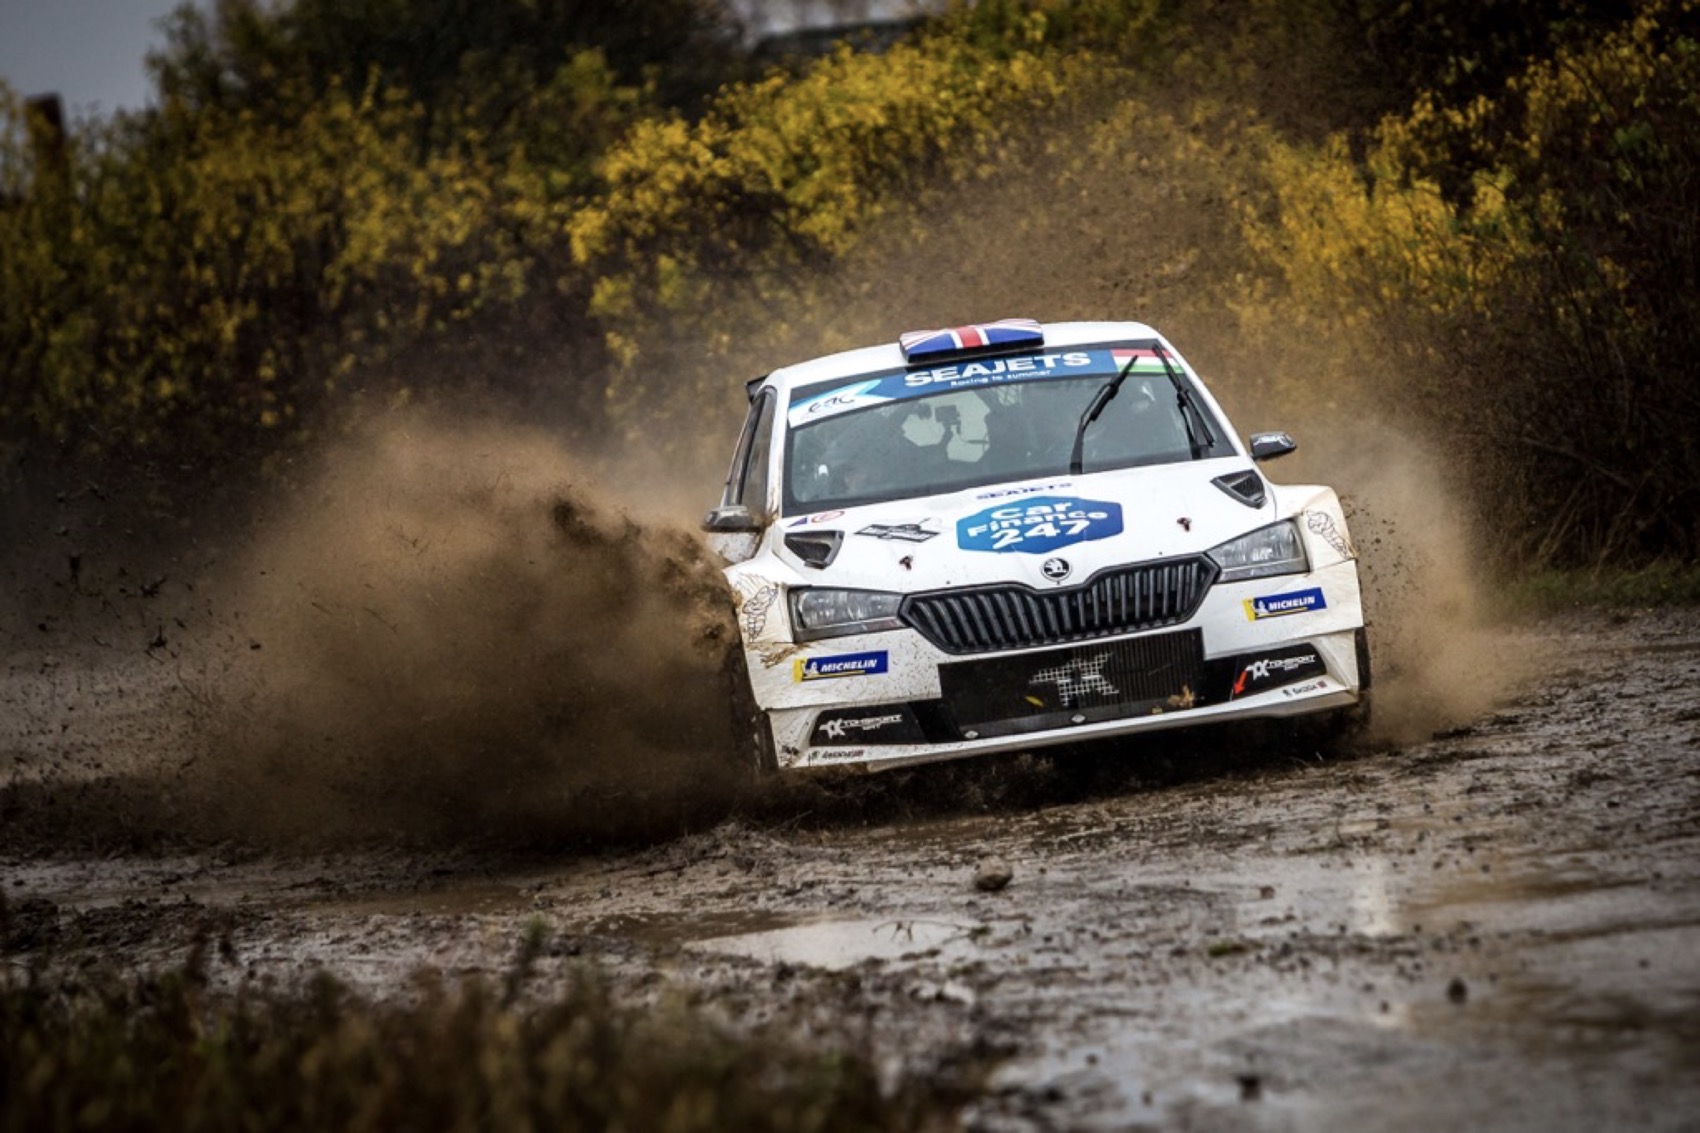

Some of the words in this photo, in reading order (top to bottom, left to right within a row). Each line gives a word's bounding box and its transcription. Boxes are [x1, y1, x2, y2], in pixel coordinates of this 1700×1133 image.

[904, 352, 1092, 387] SEAJETS
[967, 510, 1108, 537] Finance
[990, 519, 1091, 550] 247
[1267, 596, 1316, 611] MICHELIN
[821, 659, 878, 672] MICHELIN
